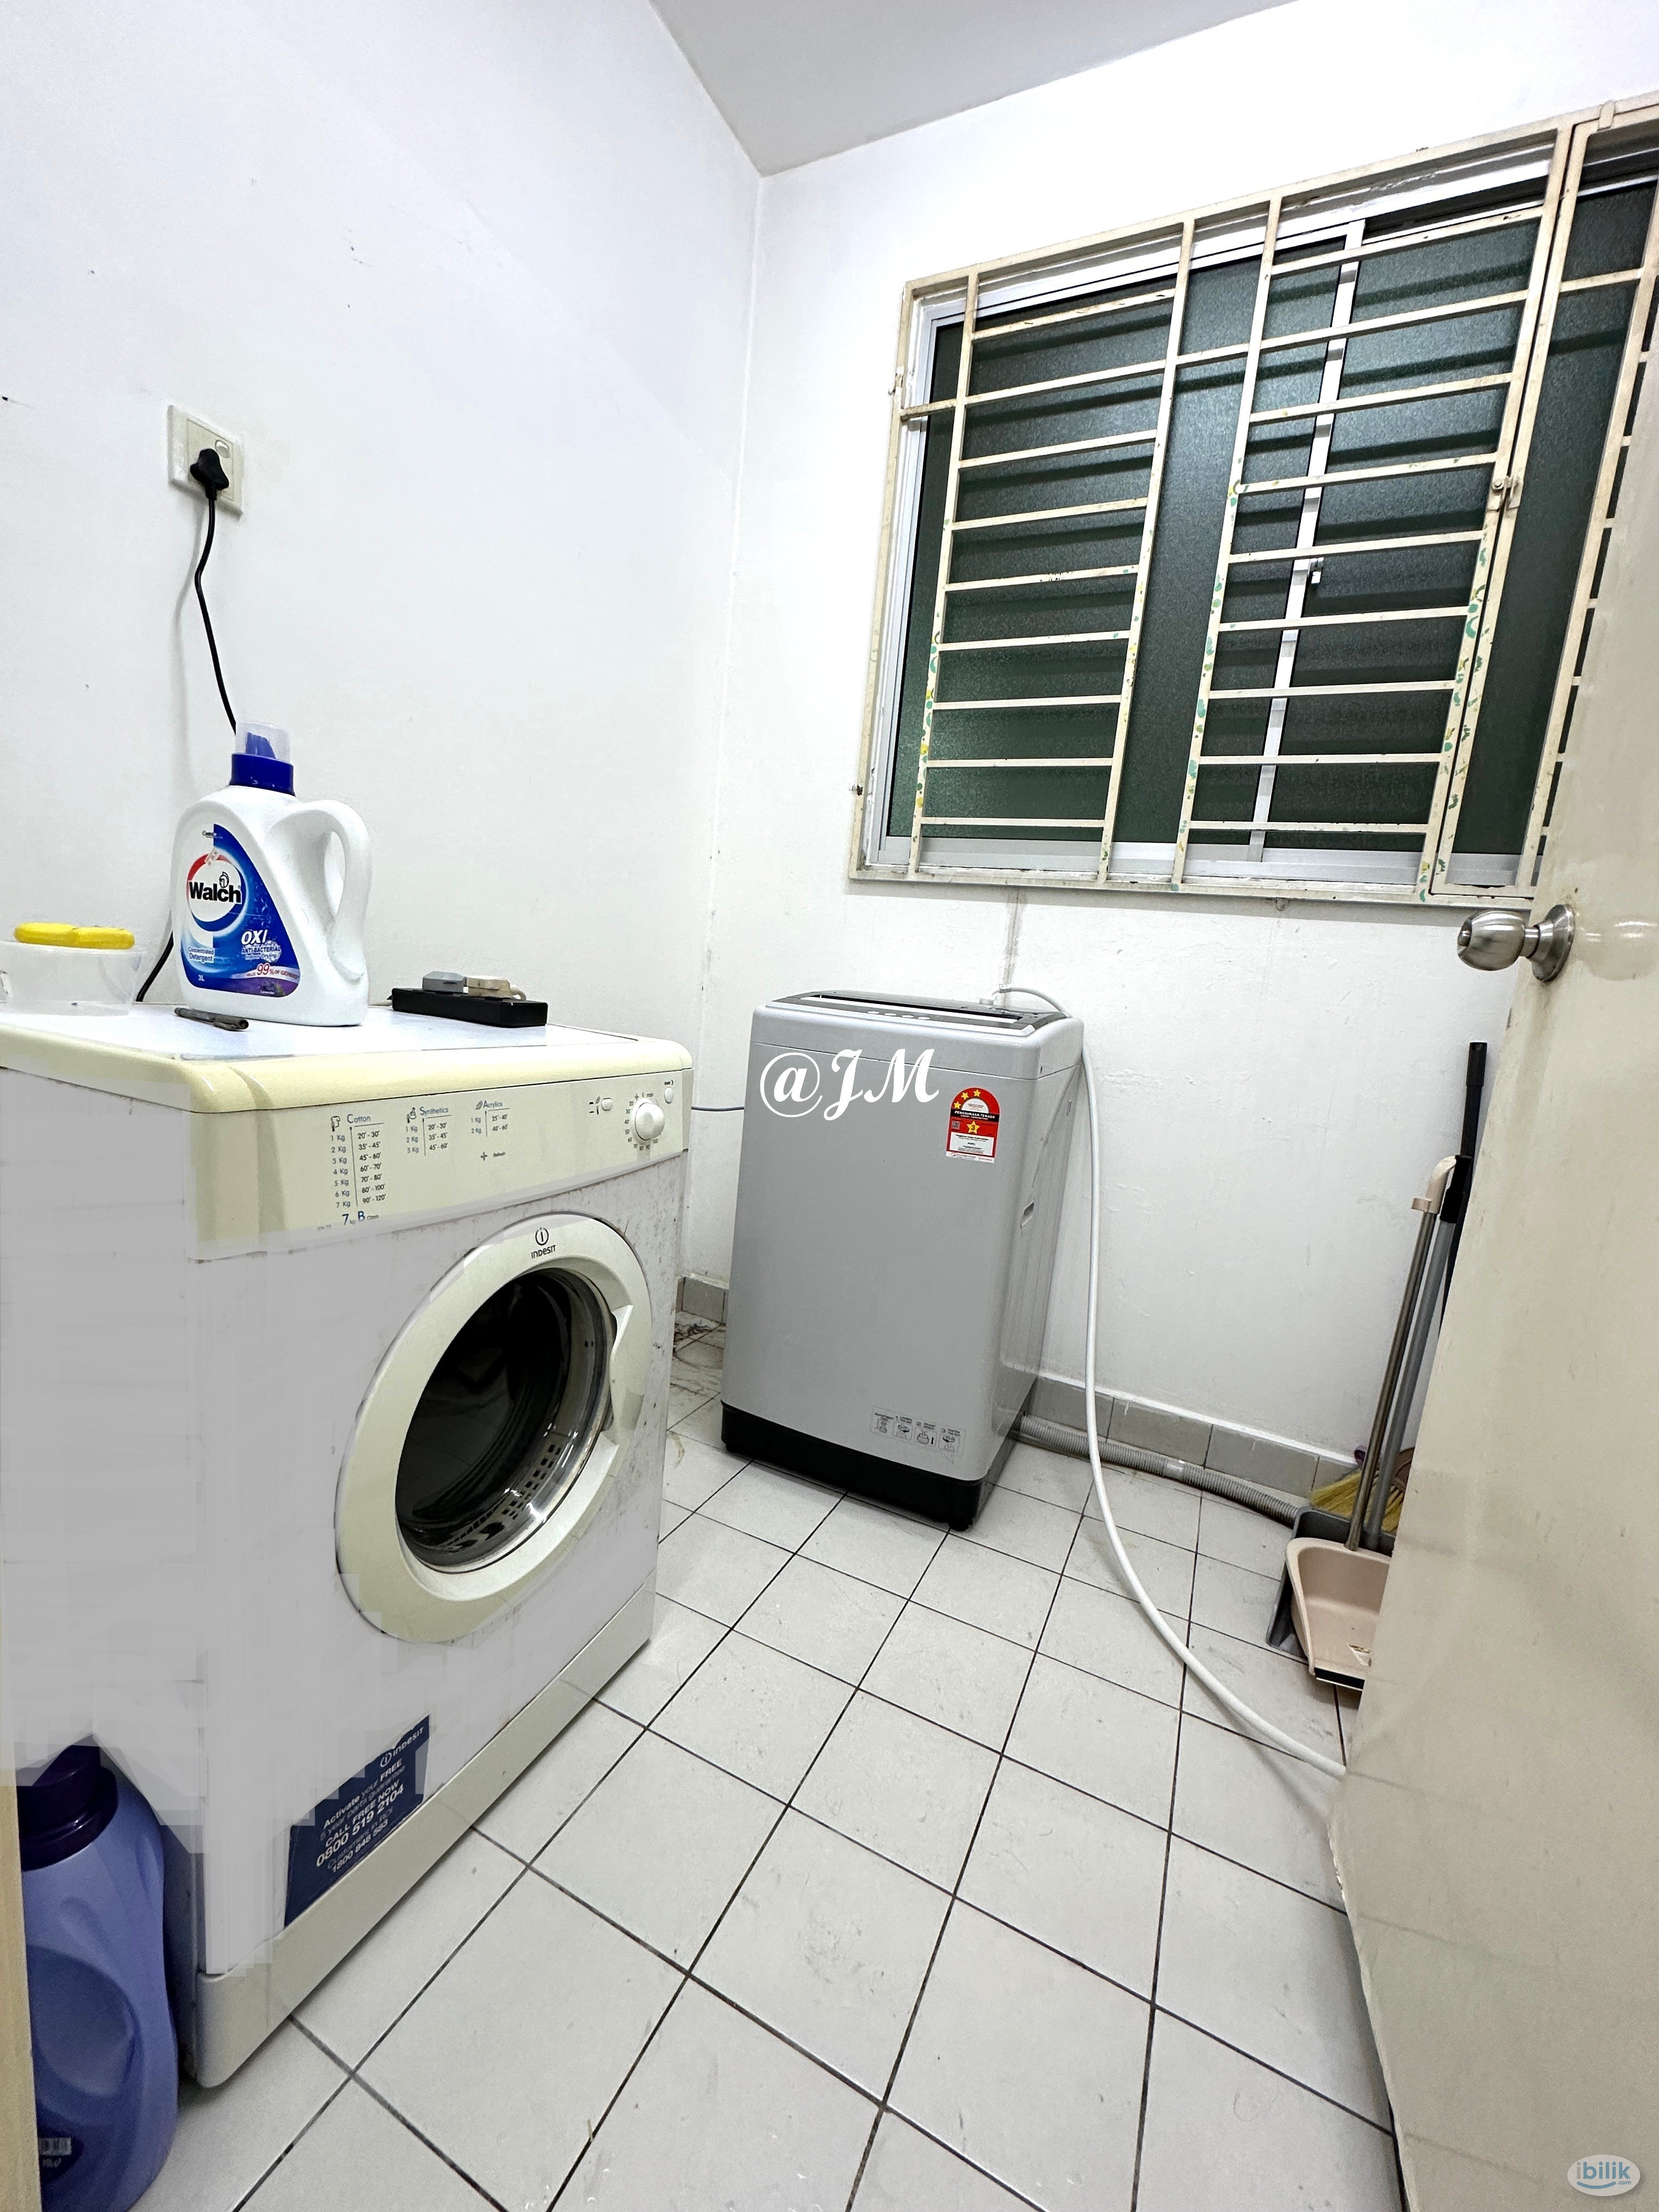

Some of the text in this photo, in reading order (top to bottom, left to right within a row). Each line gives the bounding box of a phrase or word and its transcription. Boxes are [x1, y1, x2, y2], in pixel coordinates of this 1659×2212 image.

[189, 882, 241, 903] Walch
[241, 929, 268, 945] OXI
[190, 953, 212, 962] Detergent
[347, 1114, 371, 1123] Cotton
[420, 1107, 449, 1116] Synthetics
[342, 1213, 349, 1226] 7
[358, 1211, 365, 1222] B
[323, 1795, 360, 1830] Activate
[380, 1758, 403, 1782] FREE
[326, 1779, 400, 1847] CALL FREE NOW
[317, 1783, 404, 1866] 0800 519 2104
